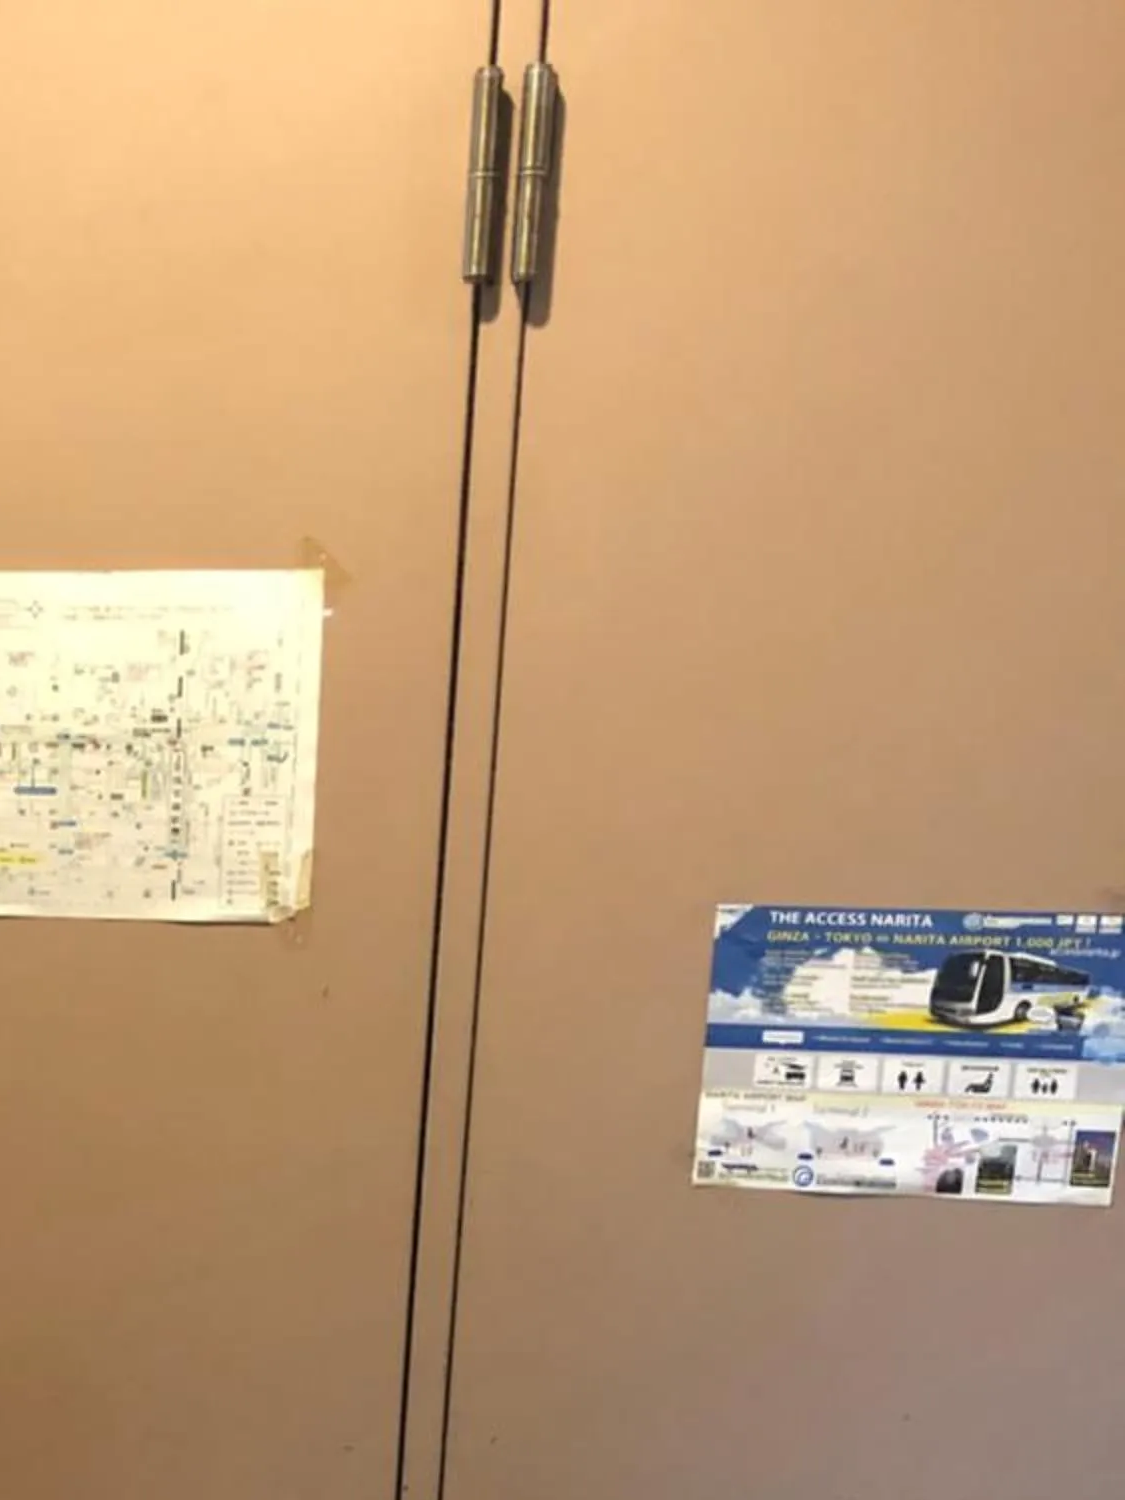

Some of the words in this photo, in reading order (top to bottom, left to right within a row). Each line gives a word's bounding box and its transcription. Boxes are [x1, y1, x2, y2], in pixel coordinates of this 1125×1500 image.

[770, 910, 800, 924] THE
[804, 911, 867, 926] ACCESS
[870, 913, 933, 928] NARITA
[766, 929, 810, 942] GINZA
[825, 931, 873, 944] TOKYO
[893, 934, 946, 947] NARITA
[949, 935, 1011, 948] AIRPORT
